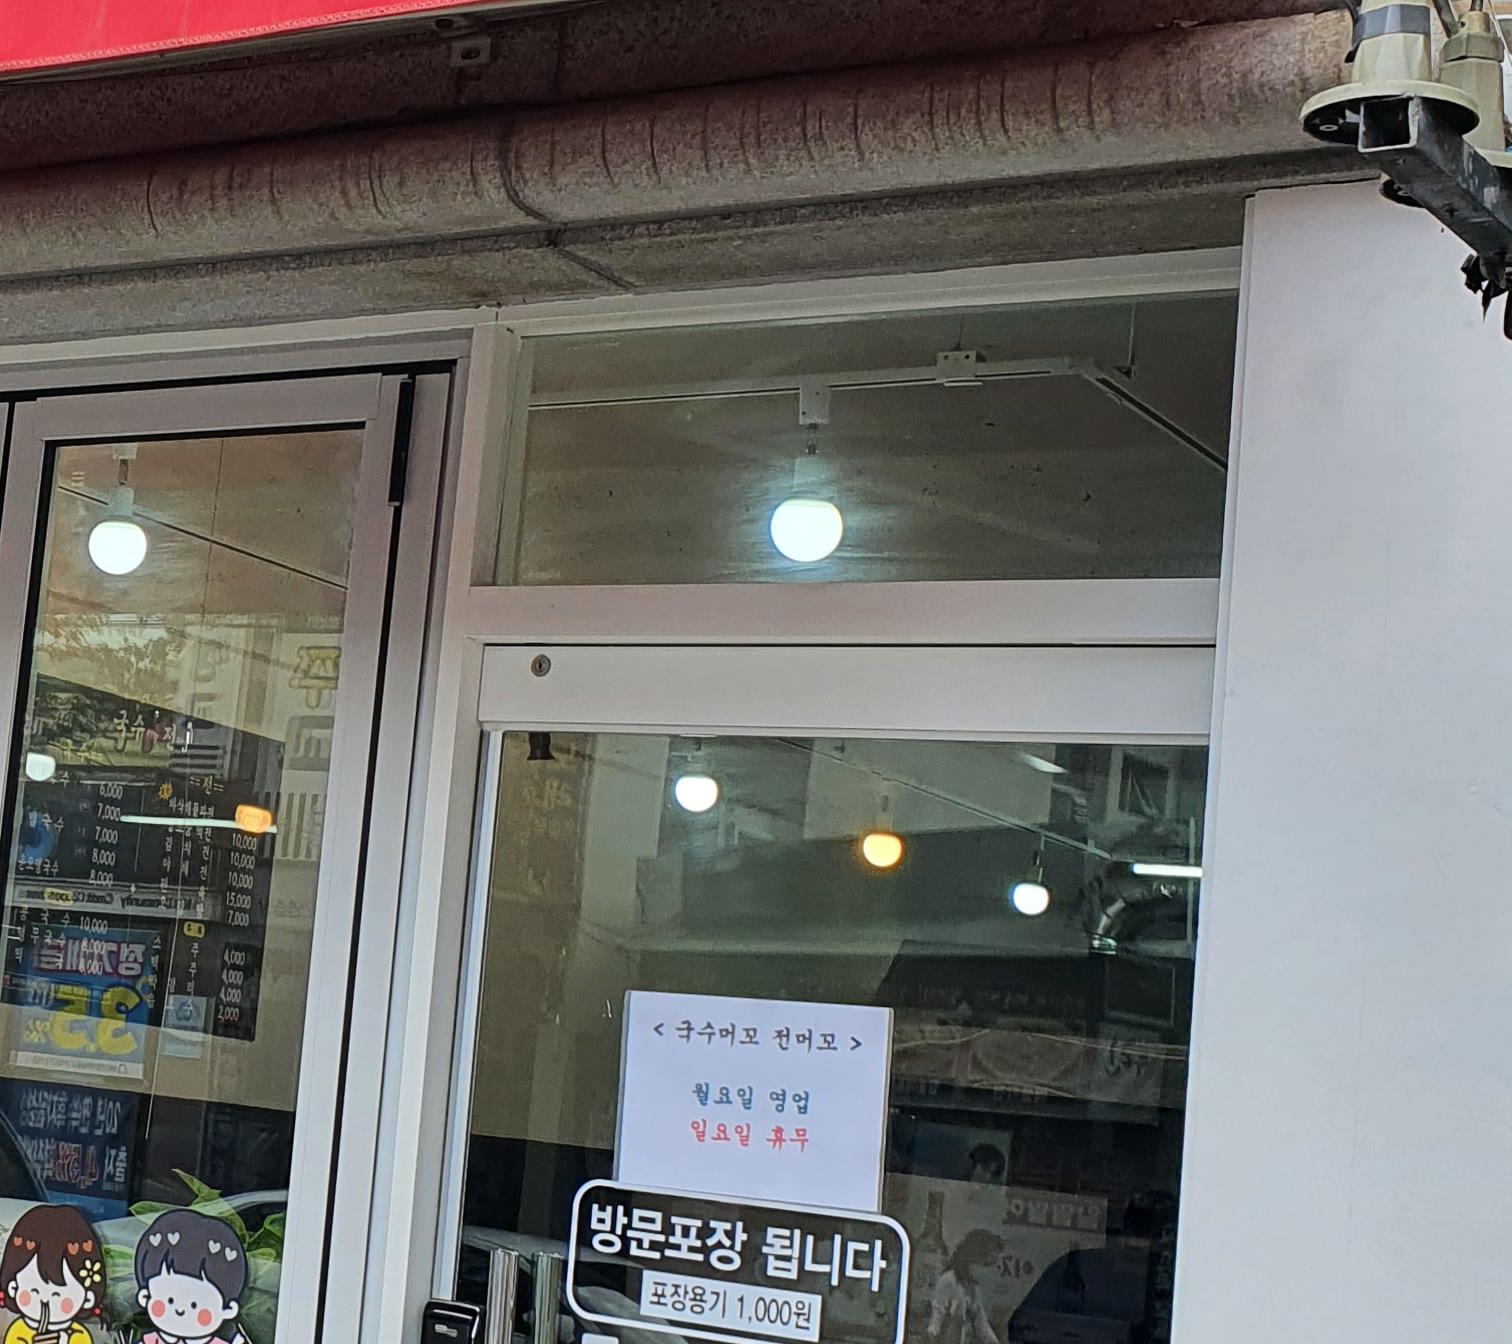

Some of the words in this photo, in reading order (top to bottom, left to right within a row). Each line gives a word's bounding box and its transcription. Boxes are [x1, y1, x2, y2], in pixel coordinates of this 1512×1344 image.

[675, 1019, 761, 1047] 국수머꼬
[772, 1026, 839, 1053] 전머꼬
[691, 1082, 754, 1110] 월요일
[768, 1089, 811, 1115] 영업
[689, 1119, 752, 1147] 일요일
[765, 1124, 810, 1153] 휴무
[589, 1202, 748, 1272] 방문포장
[761, 1227, 887, 1293] 됩니다
[648, 1282, 728, 1317] 포장용기
[735, 1293, 814, 1332] 1,000원
